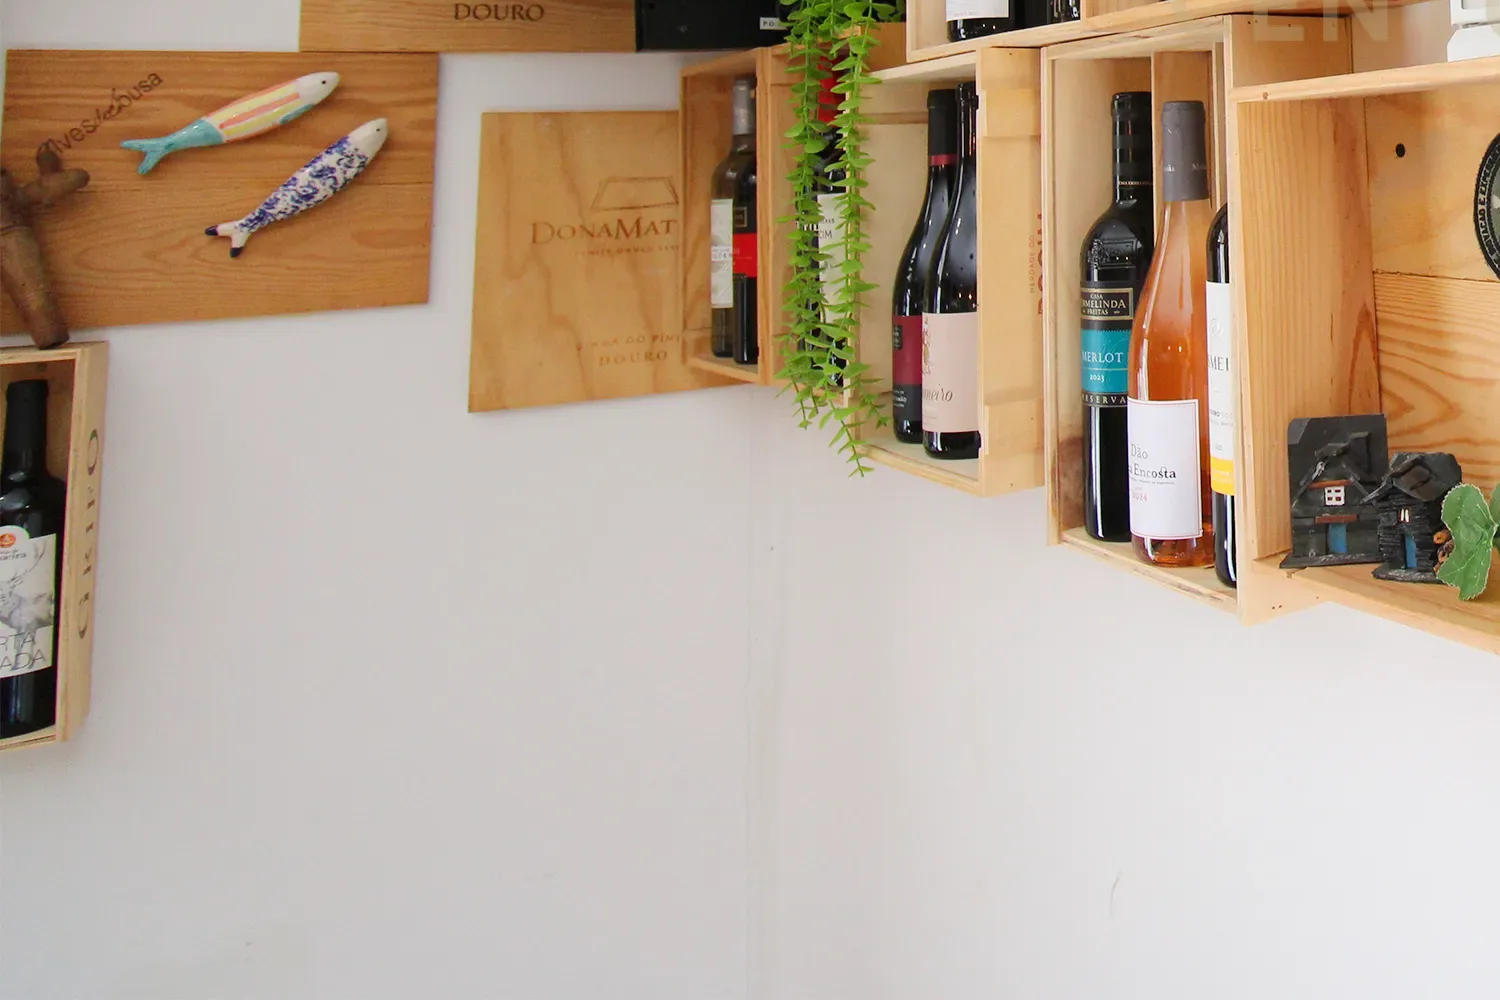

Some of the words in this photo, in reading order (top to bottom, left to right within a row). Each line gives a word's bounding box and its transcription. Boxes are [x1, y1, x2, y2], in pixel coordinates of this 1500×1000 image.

[454, 3, 544, 21] DOURO
[47, 118, 98, 155] lves
[1134, 463, 1177, 479] Encosta
